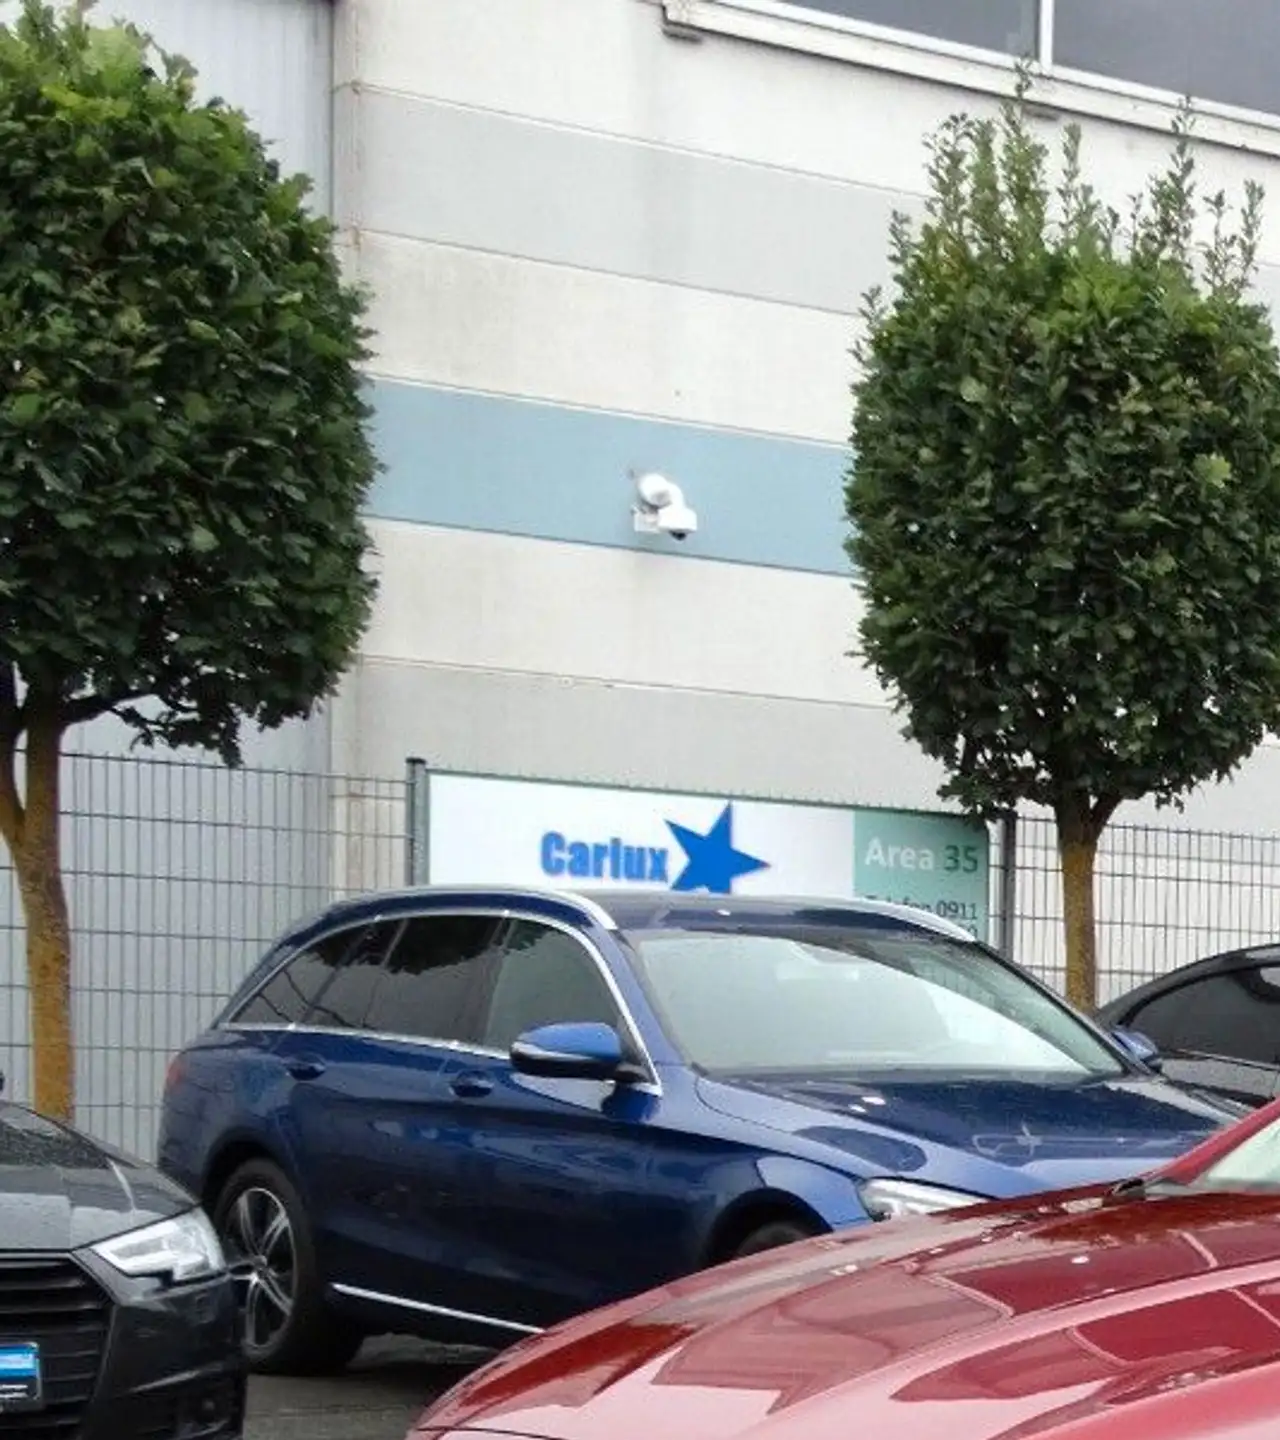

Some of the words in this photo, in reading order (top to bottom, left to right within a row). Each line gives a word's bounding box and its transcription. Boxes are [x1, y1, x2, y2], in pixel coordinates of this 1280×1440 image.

[540, 831, 668, 882] Carlux
[865, 836, 934, 871] Area
[943, 844, 978, 874] 35
